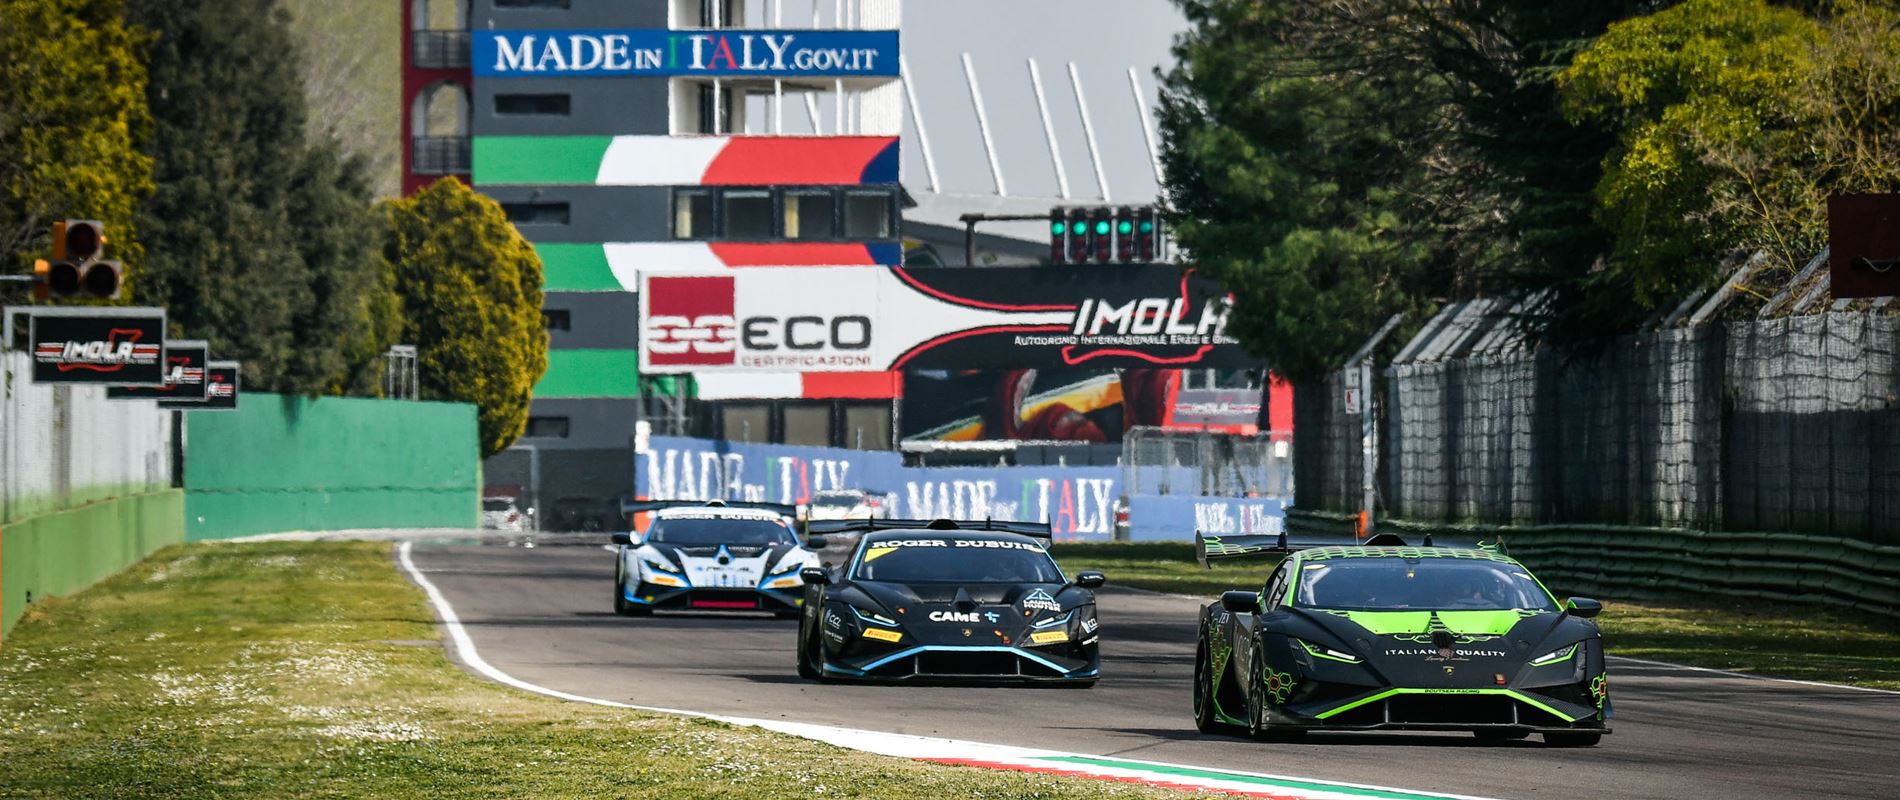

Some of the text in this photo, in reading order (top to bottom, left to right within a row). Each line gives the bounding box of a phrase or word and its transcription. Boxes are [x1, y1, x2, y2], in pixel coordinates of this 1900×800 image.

[493, 35, 631, 71] MADE
[741, 315, 872, 350] ECO
[1014, 334, 1077, 345] AUTODROMO
[63, 341, 134, 360] IMOLA
[741, 354, 872, 367] CERTIFICAZIONI
[1020, 478, 1115, 533] ITALY
[872, 539, 1037, 551] ROGER DUBUIS
[928, 610, 981, 622] CAME
[1455, 649, 1506, 657] QUALITY
